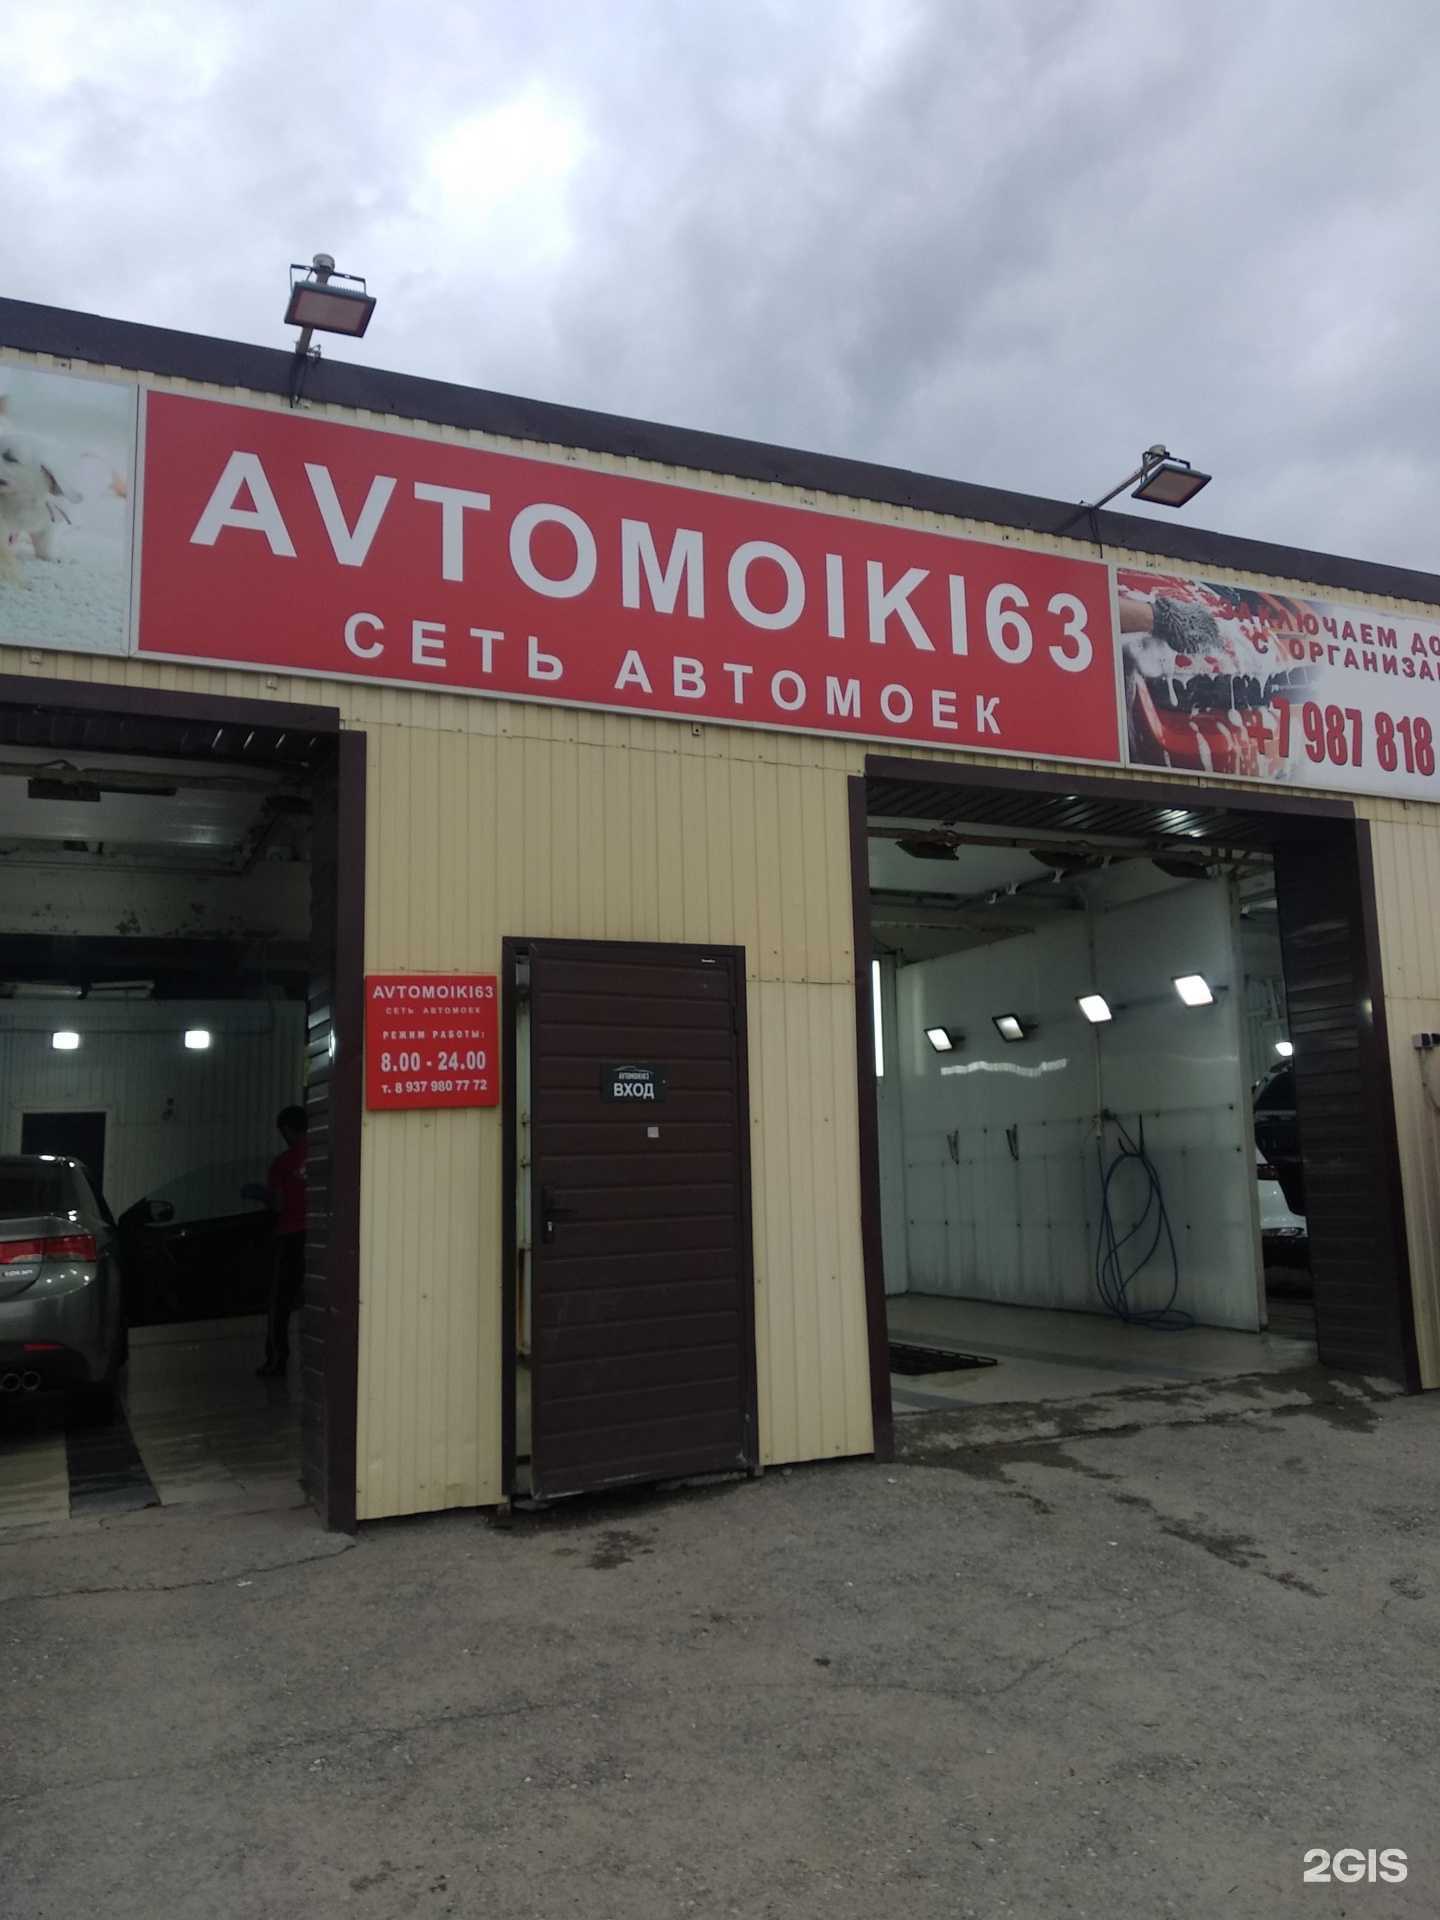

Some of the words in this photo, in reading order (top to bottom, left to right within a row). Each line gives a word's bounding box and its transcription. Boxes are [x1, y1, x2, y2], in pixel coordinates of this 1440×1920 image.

[190, 451, 1093, 673] AVTOMOIKI63
[1289, 637, 1440, 682] ОРГАНИЗА
[344, 613, 563, 681] СЕТЬ
[614, 650, 1001, 734] АВТОМОЕК
[1247, 696, 1290, 758] +7
[1303, 701, 1363, 767] 987
[1375, 711, 1435, 776] 818
[372, 985, 494, 999] AVTOMOIKI63
[385, 1007, 414, 1015] СЕТЬ
[423, 1006, 481, 1015] АВТОМОЕК
[382, 1030, 425, 1040] РЕЖИМ
[432, 1030, 485, 1039] РАБОТЫ:
[381, 1052, 420, 1072] 8.00
[438, 1051, 486, 1071] 24.00
[395, 1082, 403, 1093] 8
[405, 1081, 427, 1092] 937
[430, 1080, 453, 1092] 980
[456, 1080, 469, 1091] 77
[473, 1079, 488, 1090] 72
[613, 1082, 655, 1099] ВХОД
